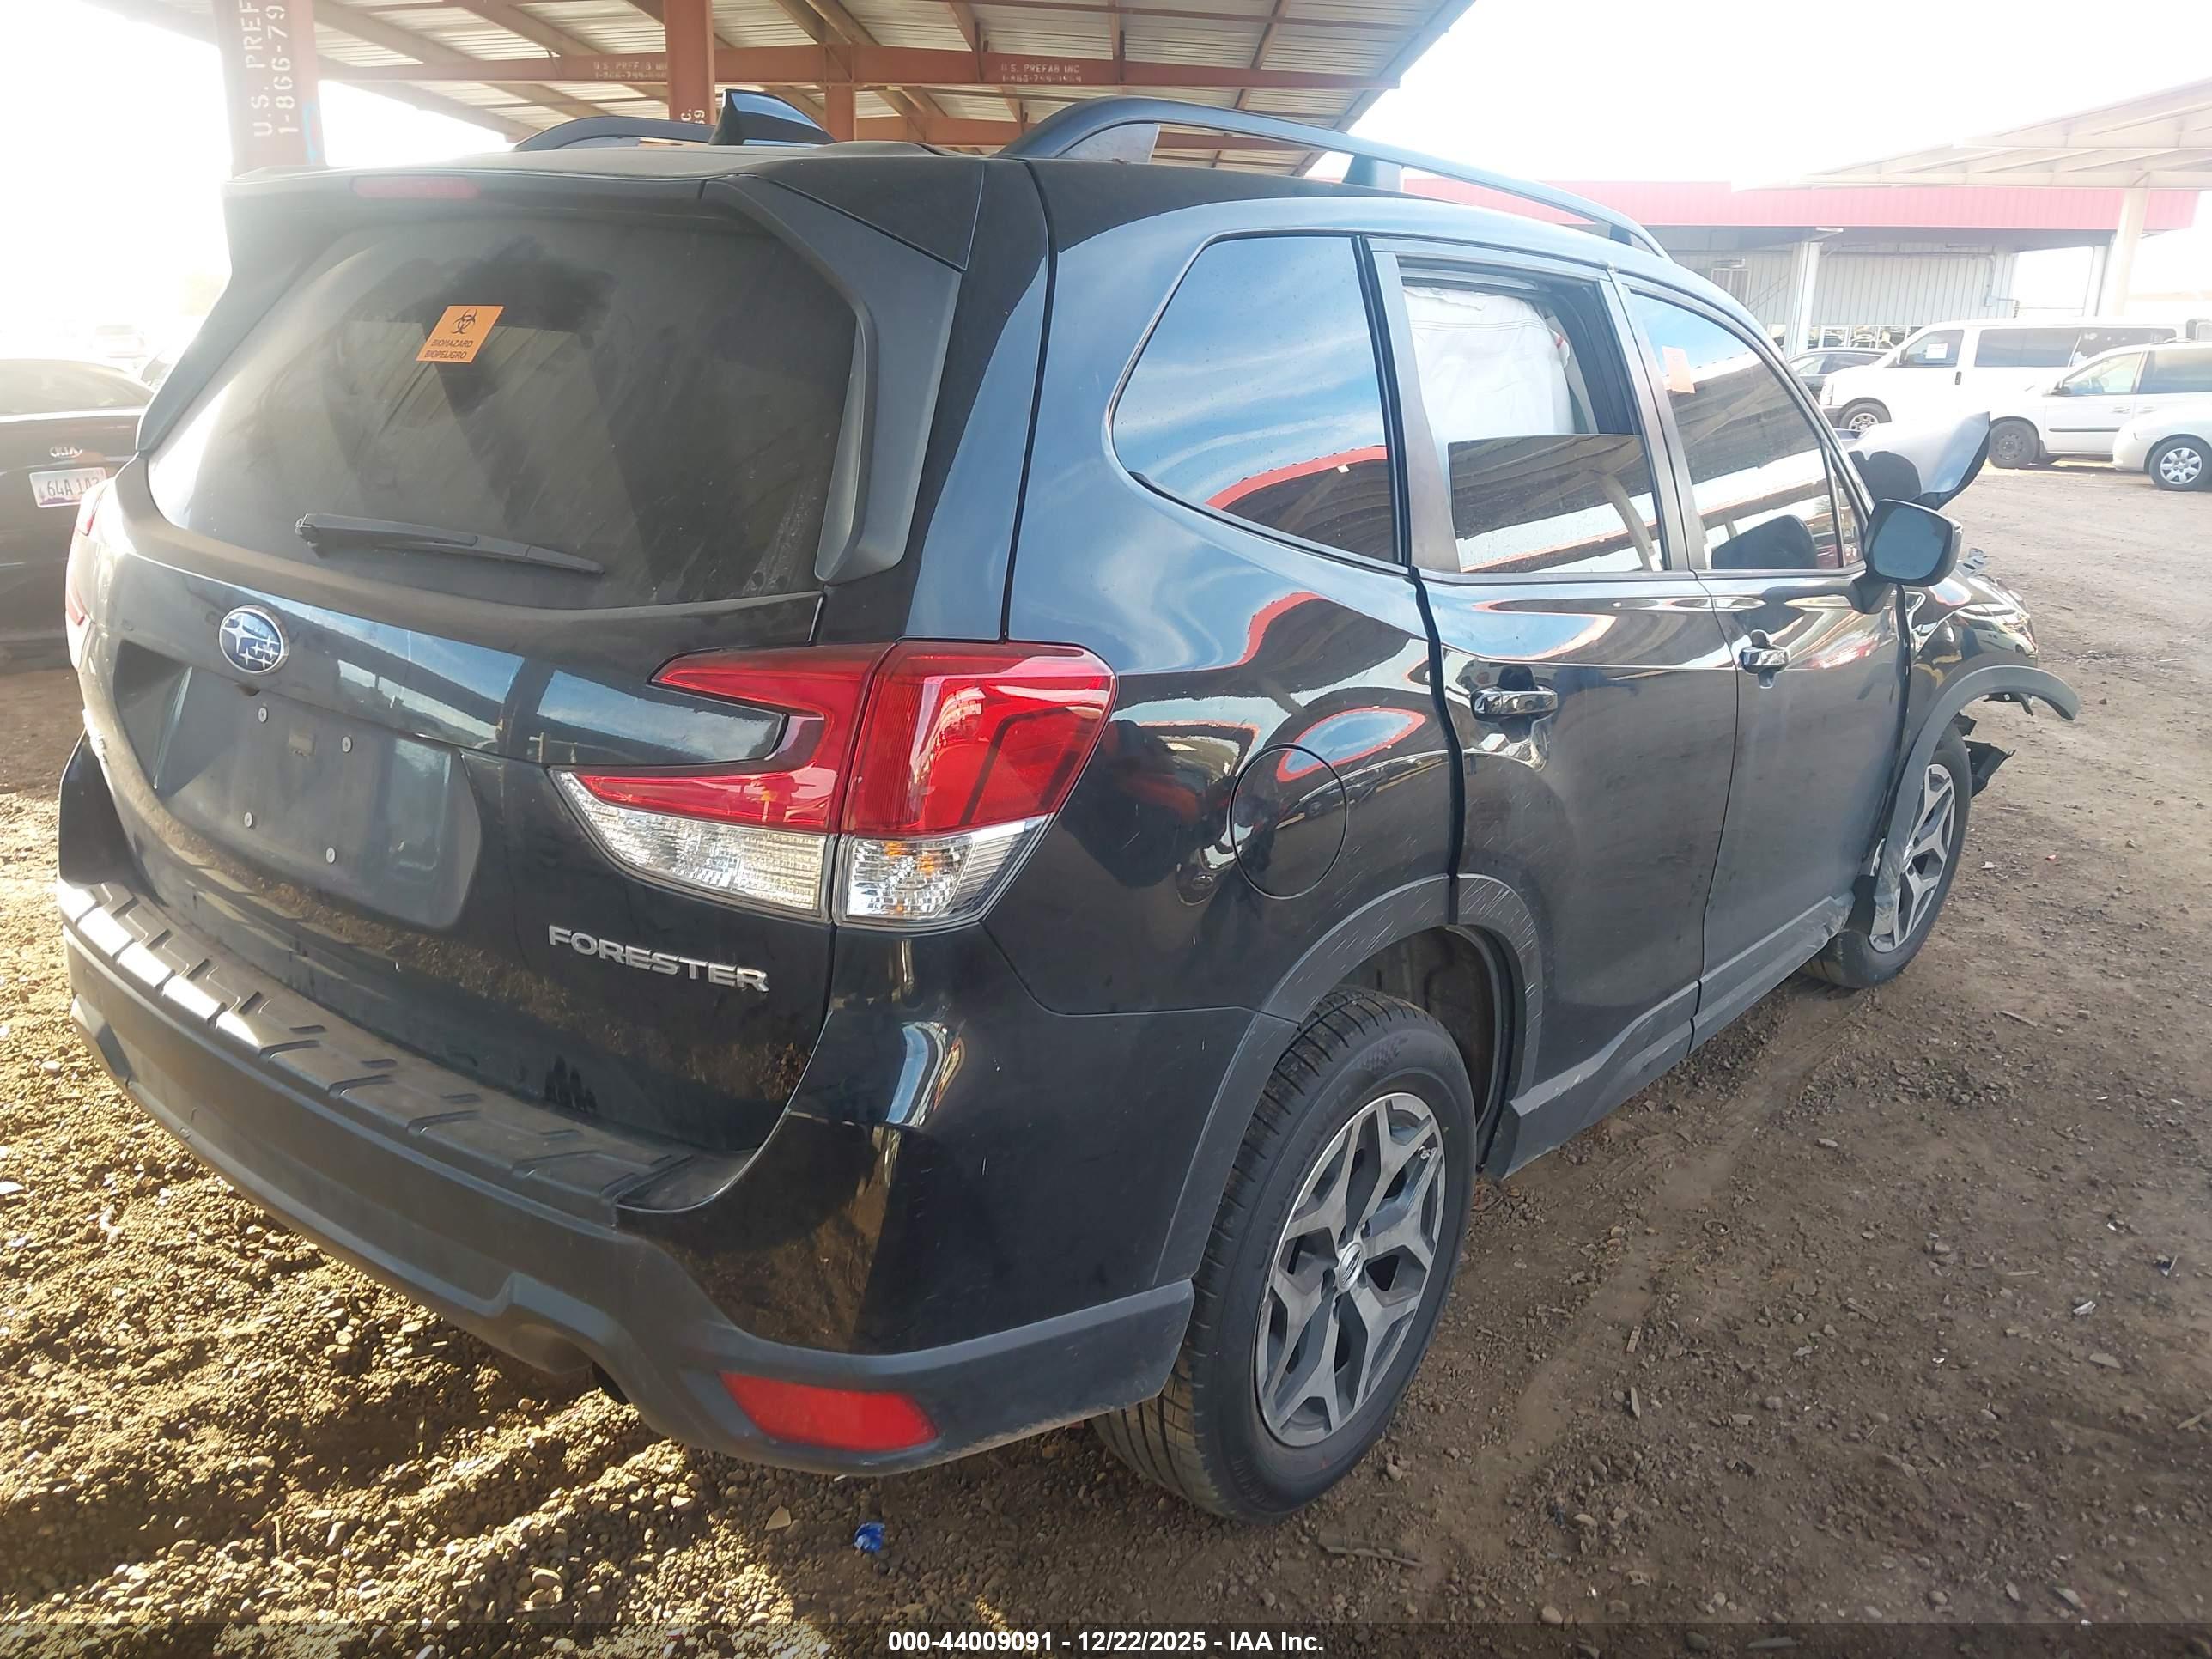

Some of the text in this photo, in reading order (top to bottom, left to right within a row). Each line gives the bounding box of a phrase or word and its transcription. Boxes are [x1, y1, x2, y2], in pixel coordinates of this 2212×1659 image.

[265, 5, 299, 134] 1-866-79
[1023, 63, 1060, 74] PREFAB
[250, 86, 273, 137] U.S.
[431, 339, 473, 348] BIOHAZARD
[424, 349, 467, 359] BIOPELIGRO
[47, 478, 73, 496] 64A
[548, 925, 769, 992] FORESTER
